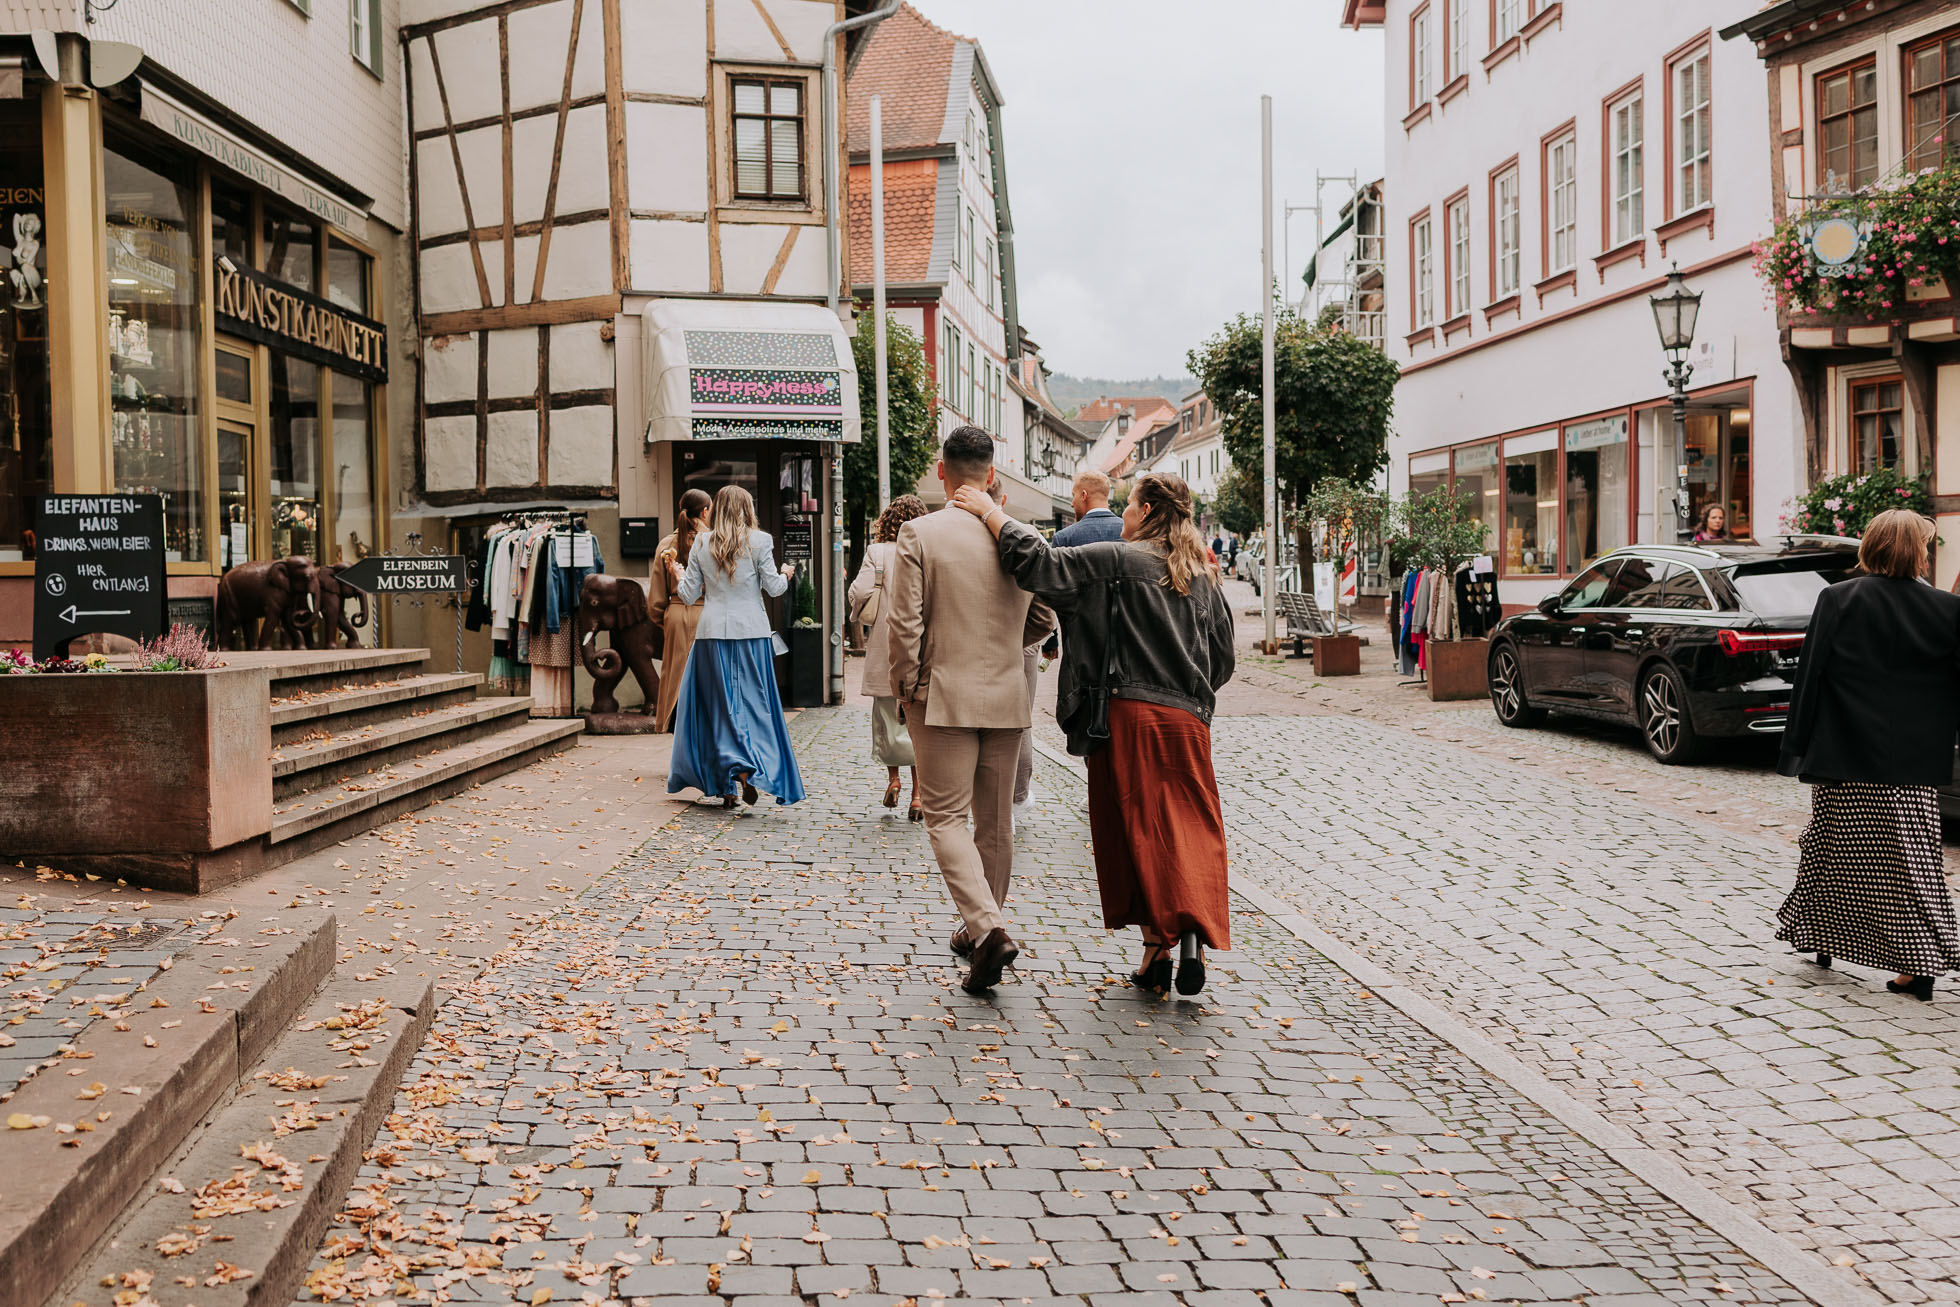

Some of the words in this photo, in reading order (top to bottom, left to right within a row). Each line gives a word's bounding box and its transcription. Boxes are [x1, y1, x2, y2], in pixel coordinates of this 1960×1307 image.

[174, 113, 282, 192] KUNSTKABINETT
[302, 187, 350, 228] VERKAUF
[216, 266, 384, 369] KUNSTKABINETT
[695, 376, 828, 398] Happyness
[727, 424, 785, 433] Accessoires
[786, 424, 804, 433] und
[805, 425, 829, 434] mehr
[45, 498, 142, 514] ELEFANTEN-
[79, 517, 119, 532] HAUS
[383, 560, 449, 571] ELFENBEIN
[377, 574, 457, 590] MUSEUM
